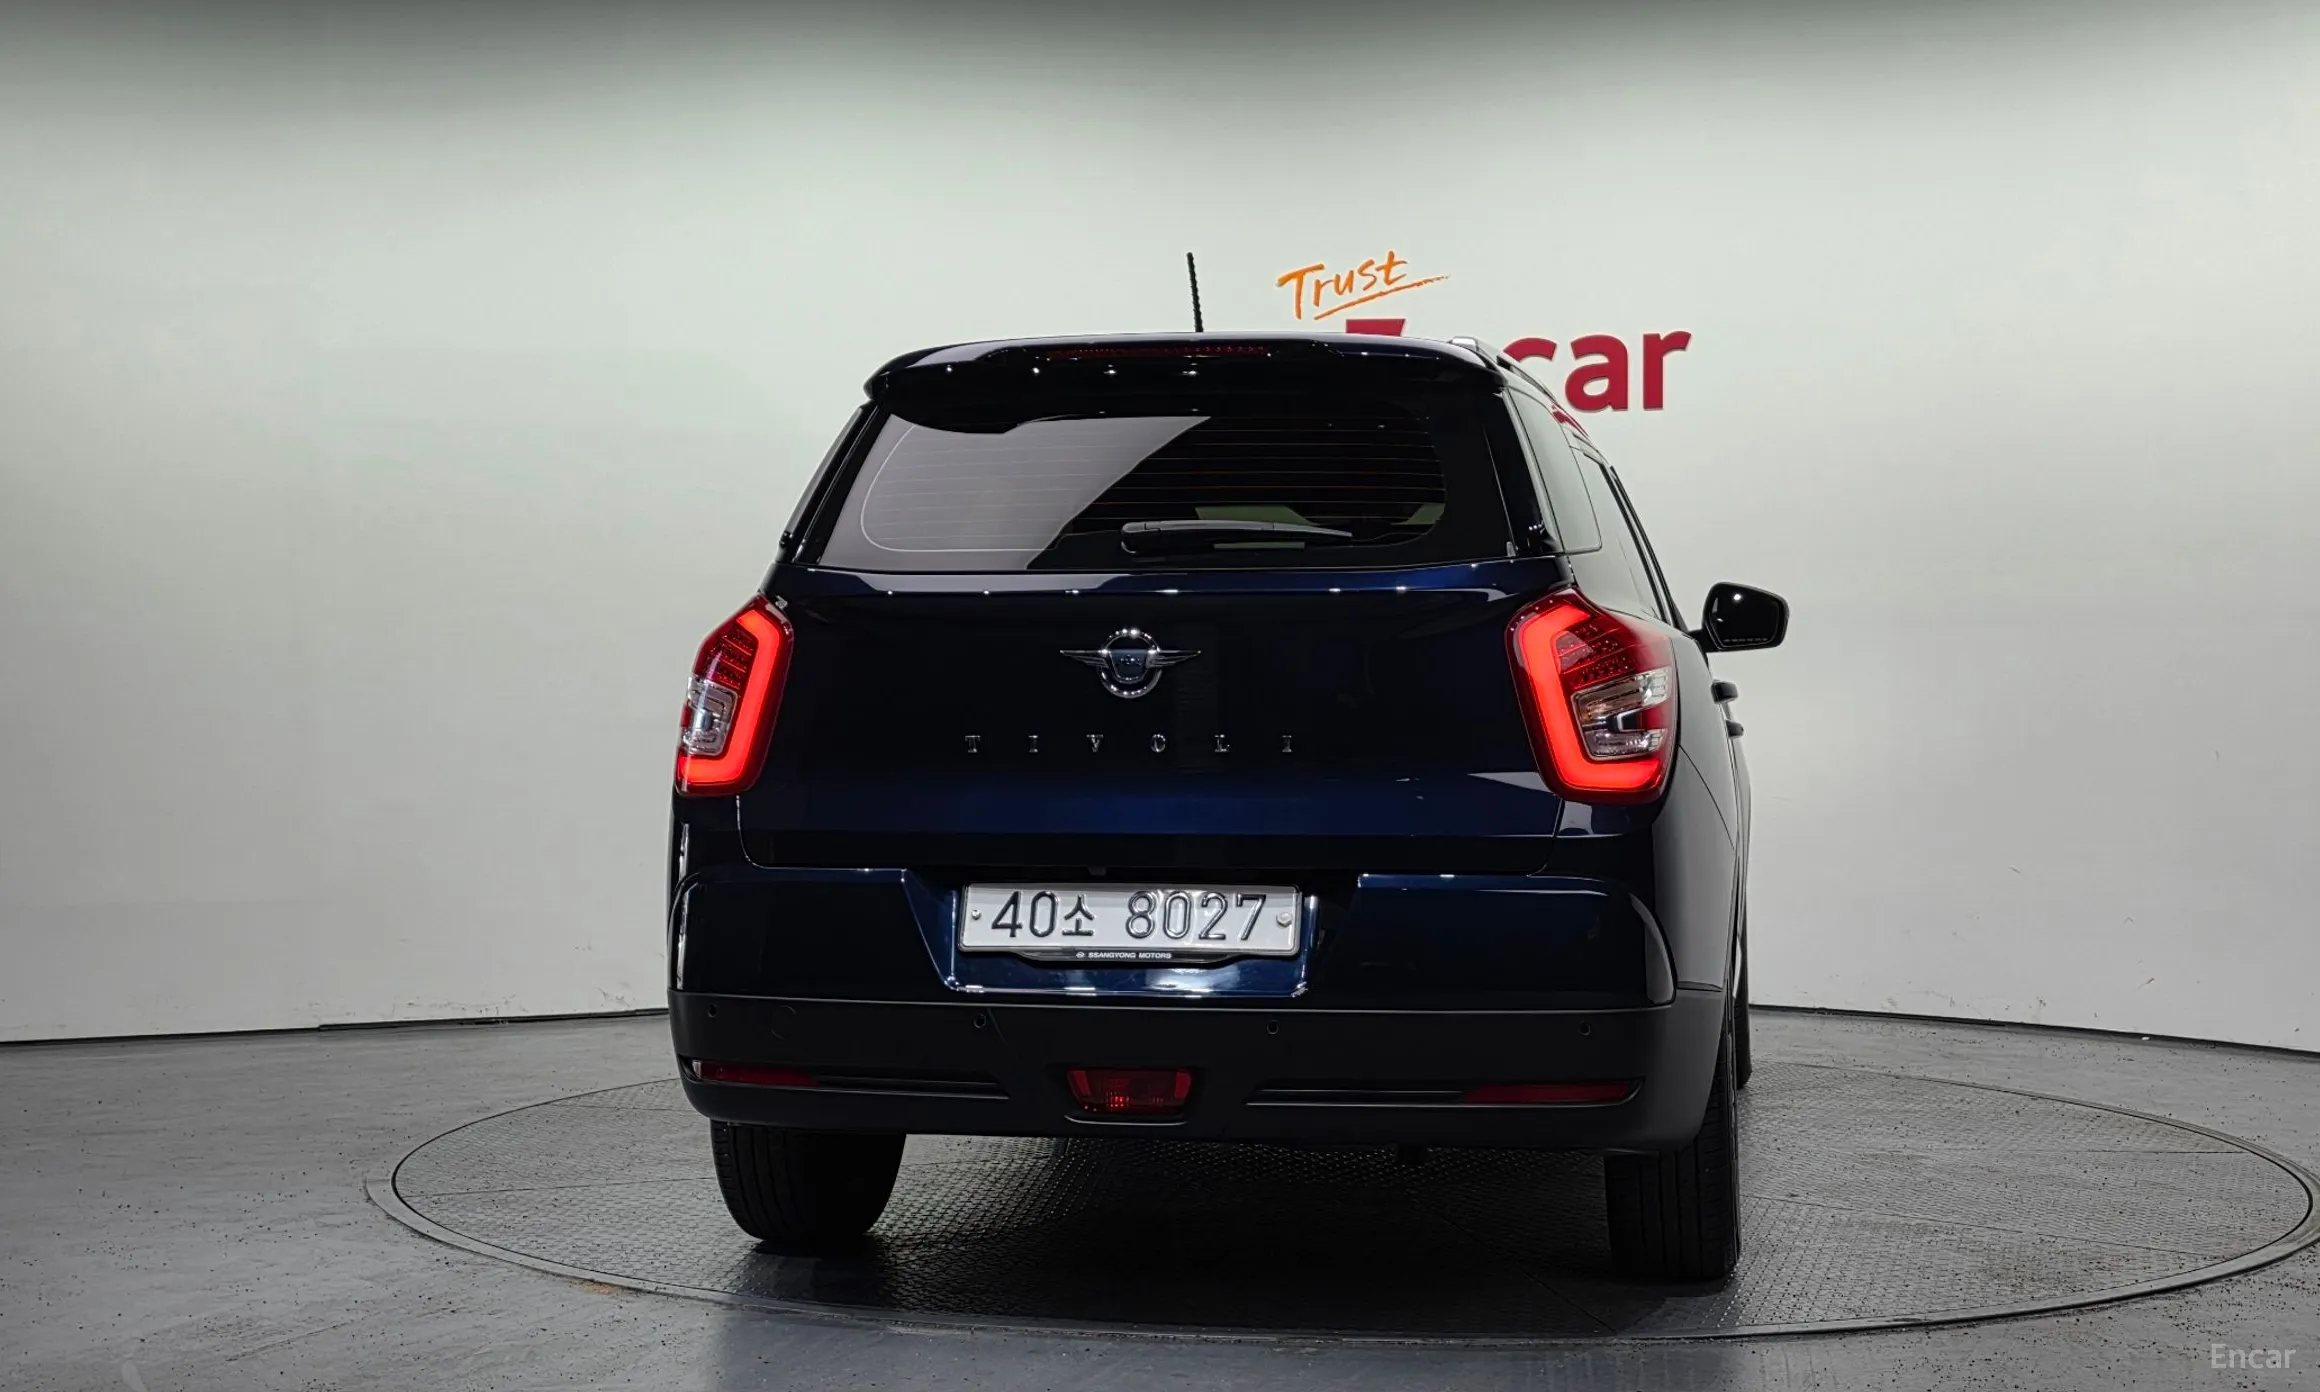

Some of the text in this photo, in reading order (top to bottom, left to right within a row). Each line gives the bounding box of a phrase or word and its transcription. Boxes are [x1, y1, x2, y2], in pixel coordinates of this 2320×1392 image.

[1276, 250, 1412, 320] Trust
[964, 734, 1292, 753] TIVOLI
[991, 890, 1268, 941] 40소 8027
[1088, 951, 1136, 959] SSANGYONG
